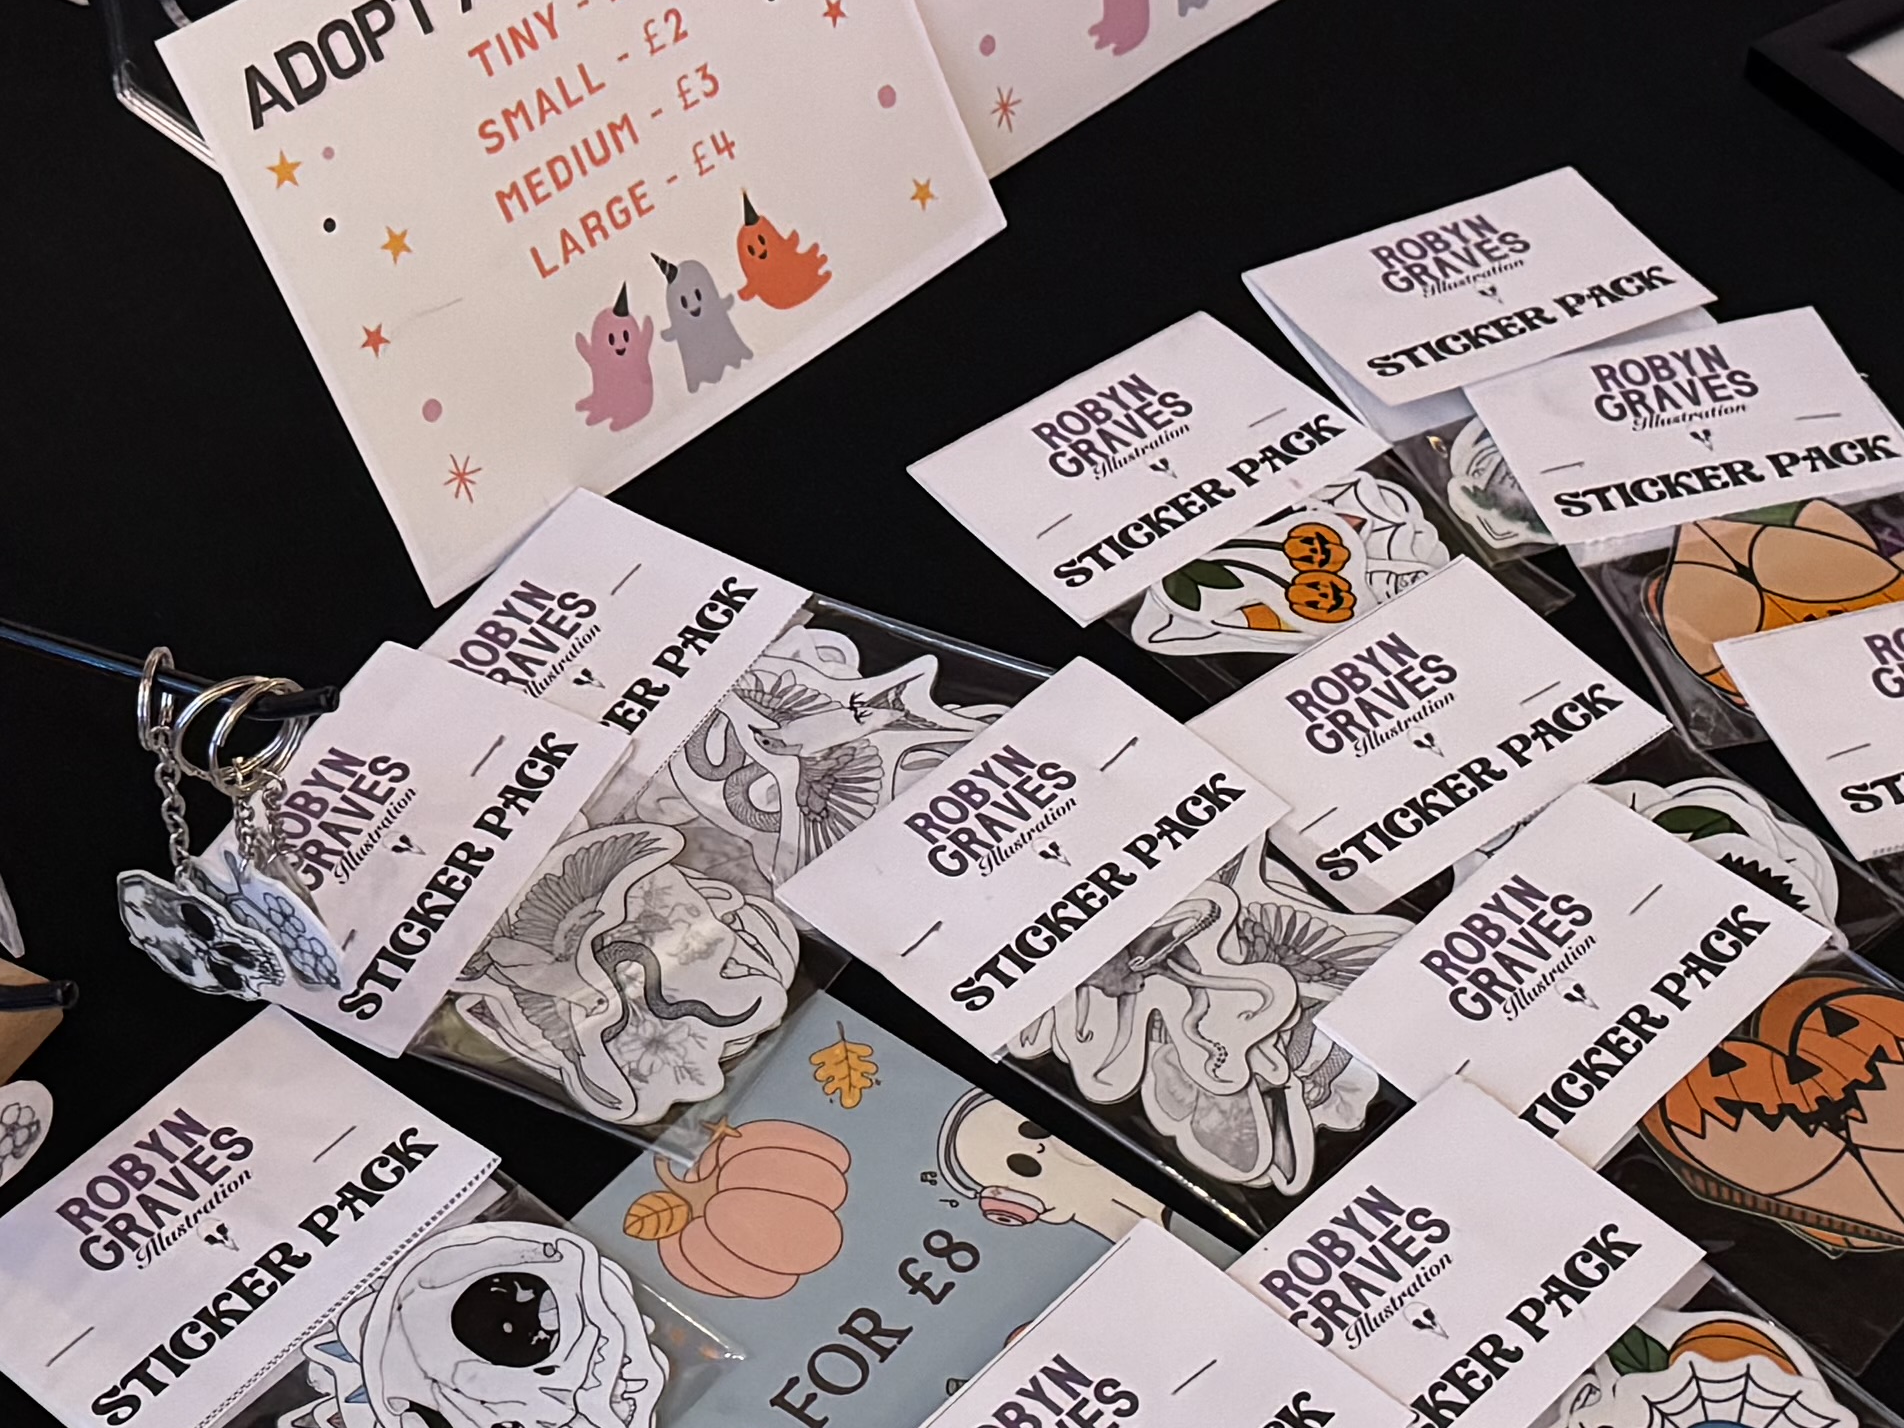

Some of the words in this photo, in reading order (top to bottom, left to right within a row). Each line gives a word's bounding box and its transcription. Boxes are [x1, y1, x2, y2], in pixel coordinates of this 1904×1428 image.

[468, 1, 563, 79] TINY
[476, 61, 606, 156] SMALL
[641, 8, 691, 58] £2
[494, 117, 641, 221] MEDIUM
[678, 65, 722, 112] £3
[531, 177, 655, 283] LARGE
[692, 131, 737, 179] £4
[1369, 214, 1505, 269] ROBYN
[1380, 231, 1531, 293] GRAVES
[1421, 256, 1525, 300] Illustration
[1367, 302, 1556, 378] STICKER
[1557, 266, 1676, 319] PACK
[1591, 345, 1728, 392] ROBYN
[1031, 374, 1158, 450] ROBYN
[1048, 388, 1194, 477] GRAVES
[1593, 370, 1762, 422] GRAVES
[1630, 403, 1748, 433] Illustration
[1053, 476, 1238, 589] STICKER
[1228, 415, 1349, 487] PACK
[1090, 424, 1191, 483] Illustration
[1554, 460, 1767, 521] STICKER
[1765, 434, 1902, 479] PACK
[448, 579, 557, 675] OBYN
[485, 591, 597, 685] RAVES
[653, 577, 758, 678] PACK
[1284, 633, 1421, 721] ROBYN
[1303, 654, 1459, 755] GRAVES
[1353, 688, 1456, 759] Illustration
[274, 746, 367, 844] OBYN
[904, 744, 1038, 844] ROBYN
[927, 763, 1077, 878] GRAVES
[1315, 758, 1508, 883] STICKER
[1496, 683, 1624, 770] PACK
[334, 788, 417, 884] Illustration
[338, 831, 495, 1021] STICKER
[472, 731, 578, 841] PACK
[977, 799, 1077, 877] Illustration
[950, 858, 1138, 1013] STICKER
[1123, 773, 1246, 870] PACK
[1421, 874, 1549, 988] ROBYN
[1448, 894, 1594, 1022] GRAVES
[1502, 933, 1597, 1022] Illustration
[1518, 1003, 1670, 1139] TICKER
[1649, 904, 1771, 1011] PACK
[55, 1108, 212, 1238] ROBYN
[77, 1125, 255, 1272] GRAVES
[134, 1168, 254, 1269] Illustration
[92, 1242, 314, 1427] STICKER
[300, 1128, 438, 1250] PACK
[899, 1229, 982, 1304] £8
[1260, 1184, 1405, 1310] ROBYN
[1507, 1224, 1642, 1341] PACK
[1345, 1253, 1454, 1349] Illustration
